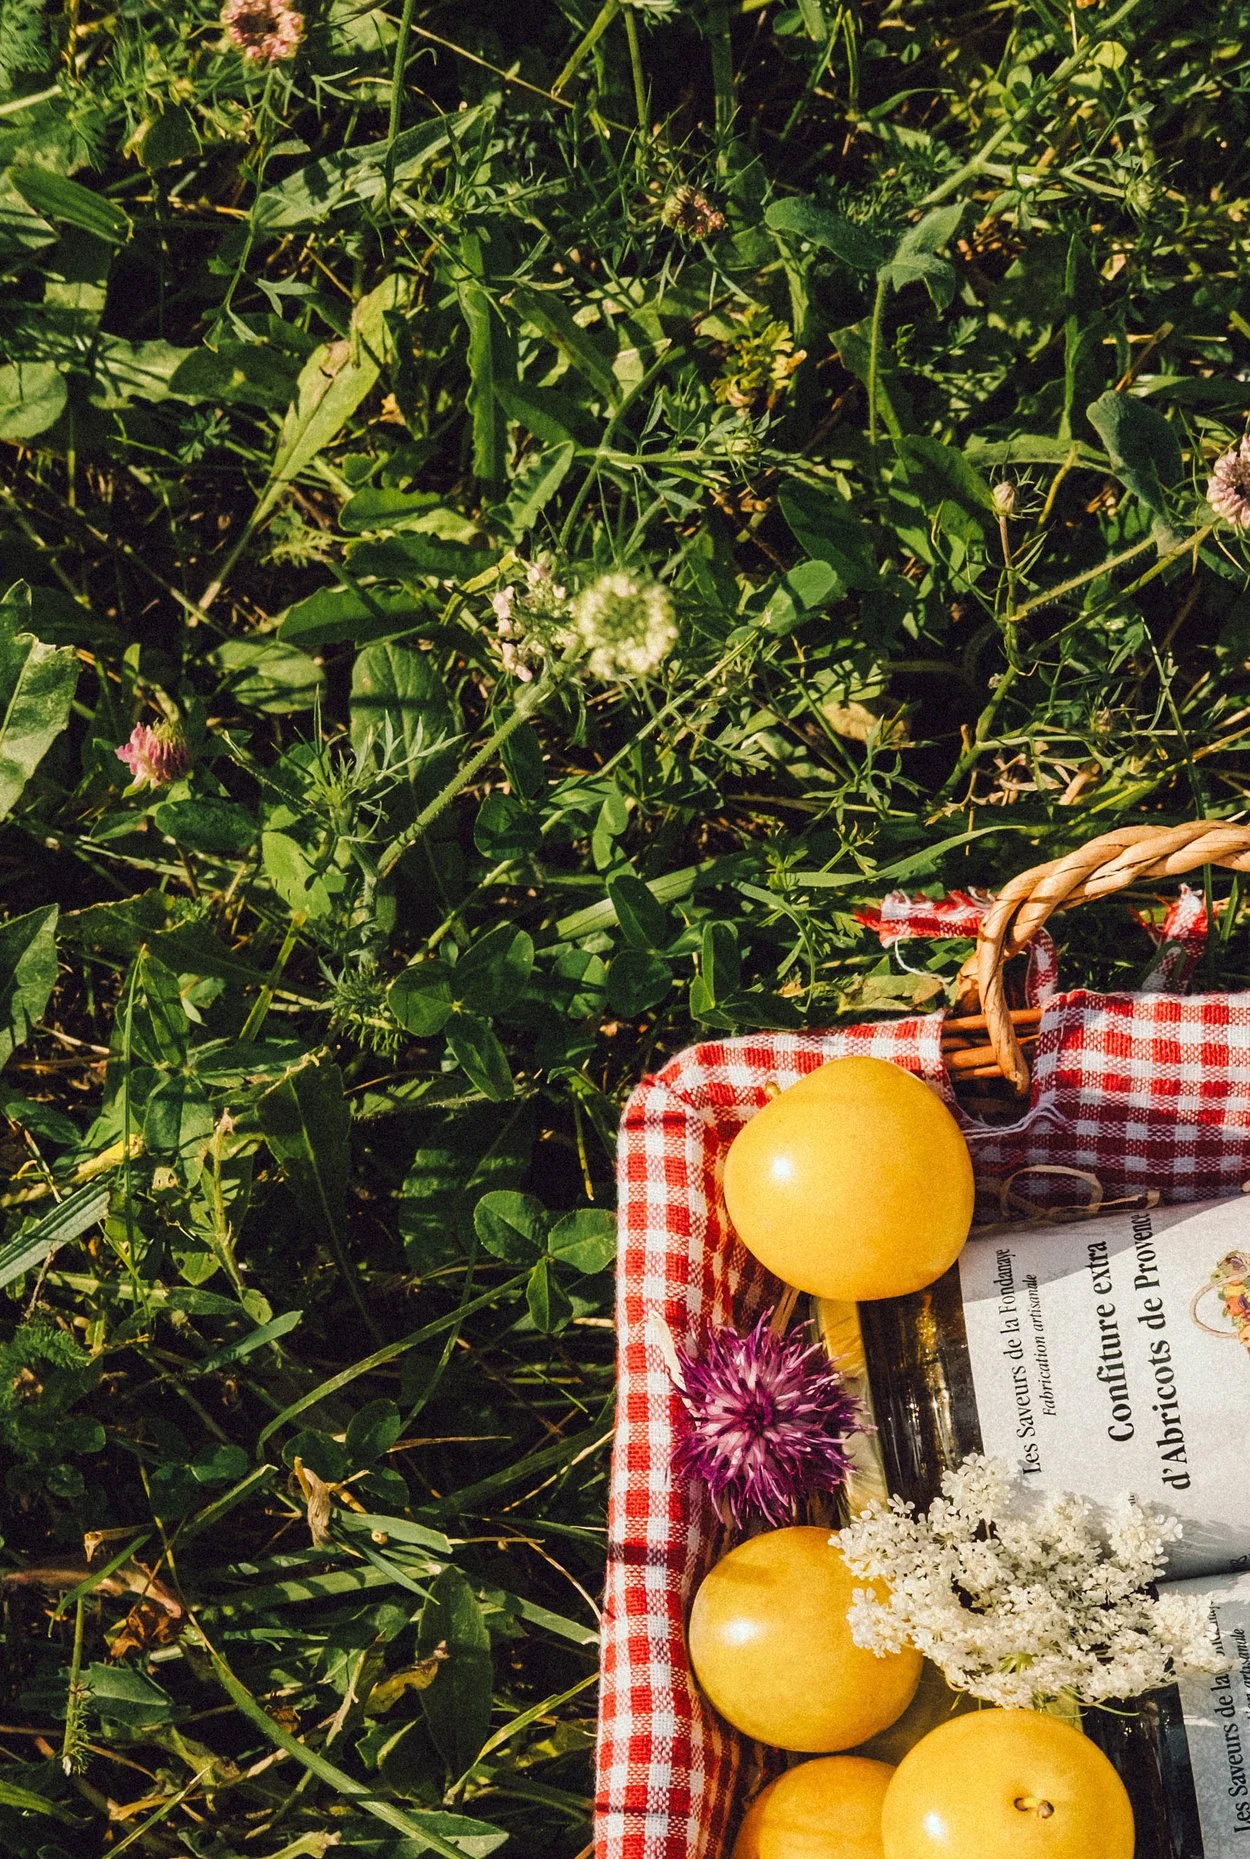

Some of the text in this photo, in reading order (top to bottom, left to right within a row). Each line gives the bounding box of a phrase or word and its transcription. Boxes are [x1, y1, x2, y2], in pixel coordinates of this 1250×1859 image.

[993, 1249, 1042, 1475] Les Saveurs de la Fondanaye
[1022, 1274, 1057, 1416] Fabrication artisanale
[1087, 1240, 1135, 1442] Confiture extra
[1129, 1213, 1192, 1490] d'Abricots de Provence
[1210, 1674, 1232, 1690] la
[1214, 1695, 1235, 1718] de
[1221, 1723, 1248, 1796] Saveurs
